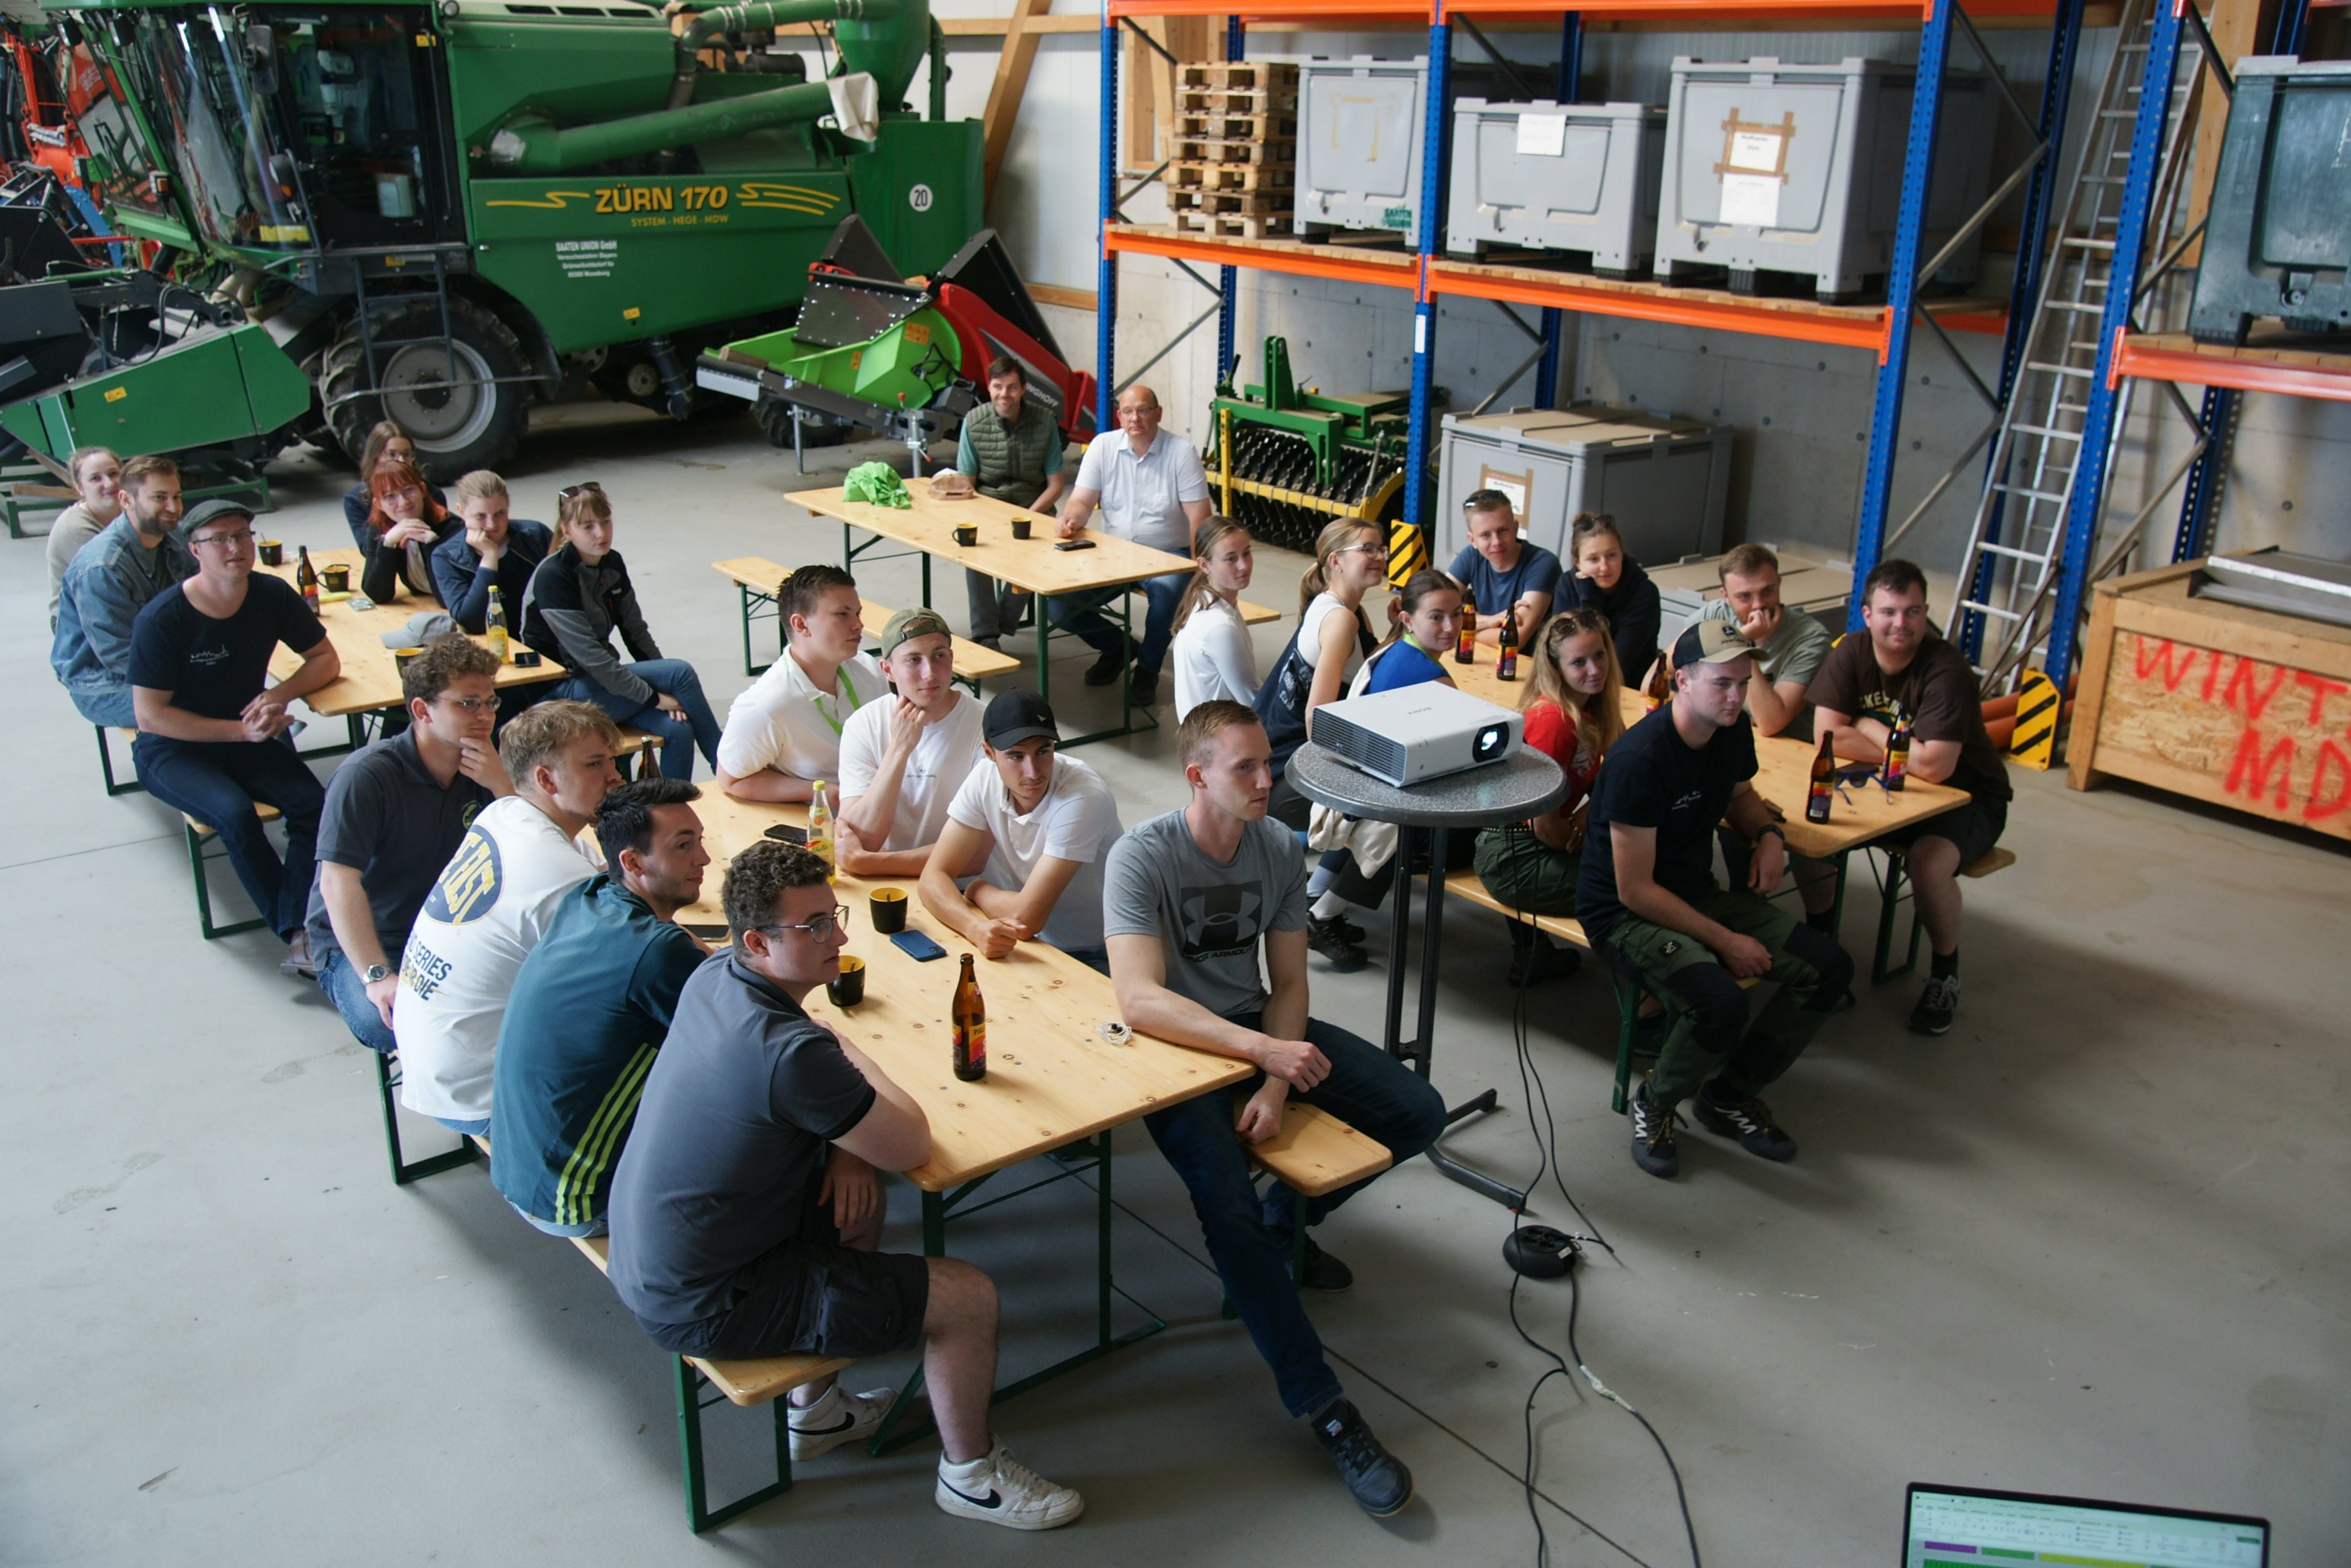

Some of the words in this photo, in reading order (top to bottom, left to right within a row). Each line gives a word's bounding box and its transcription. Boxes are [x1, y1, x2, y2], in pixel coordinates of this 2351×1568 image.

[594, 182, 674, 213] ZÜRN
[681, 185, 728, 210] 170
[914, 188, 928, 207] 20
[631, 217, 667, 227] SYSTEM
[673, 216, 698, 225] HEGE
[704, 214, 730, 223] MDW
[2224, 727, 2351, 820] MD
[413, 940, 453, 982] SERIES
